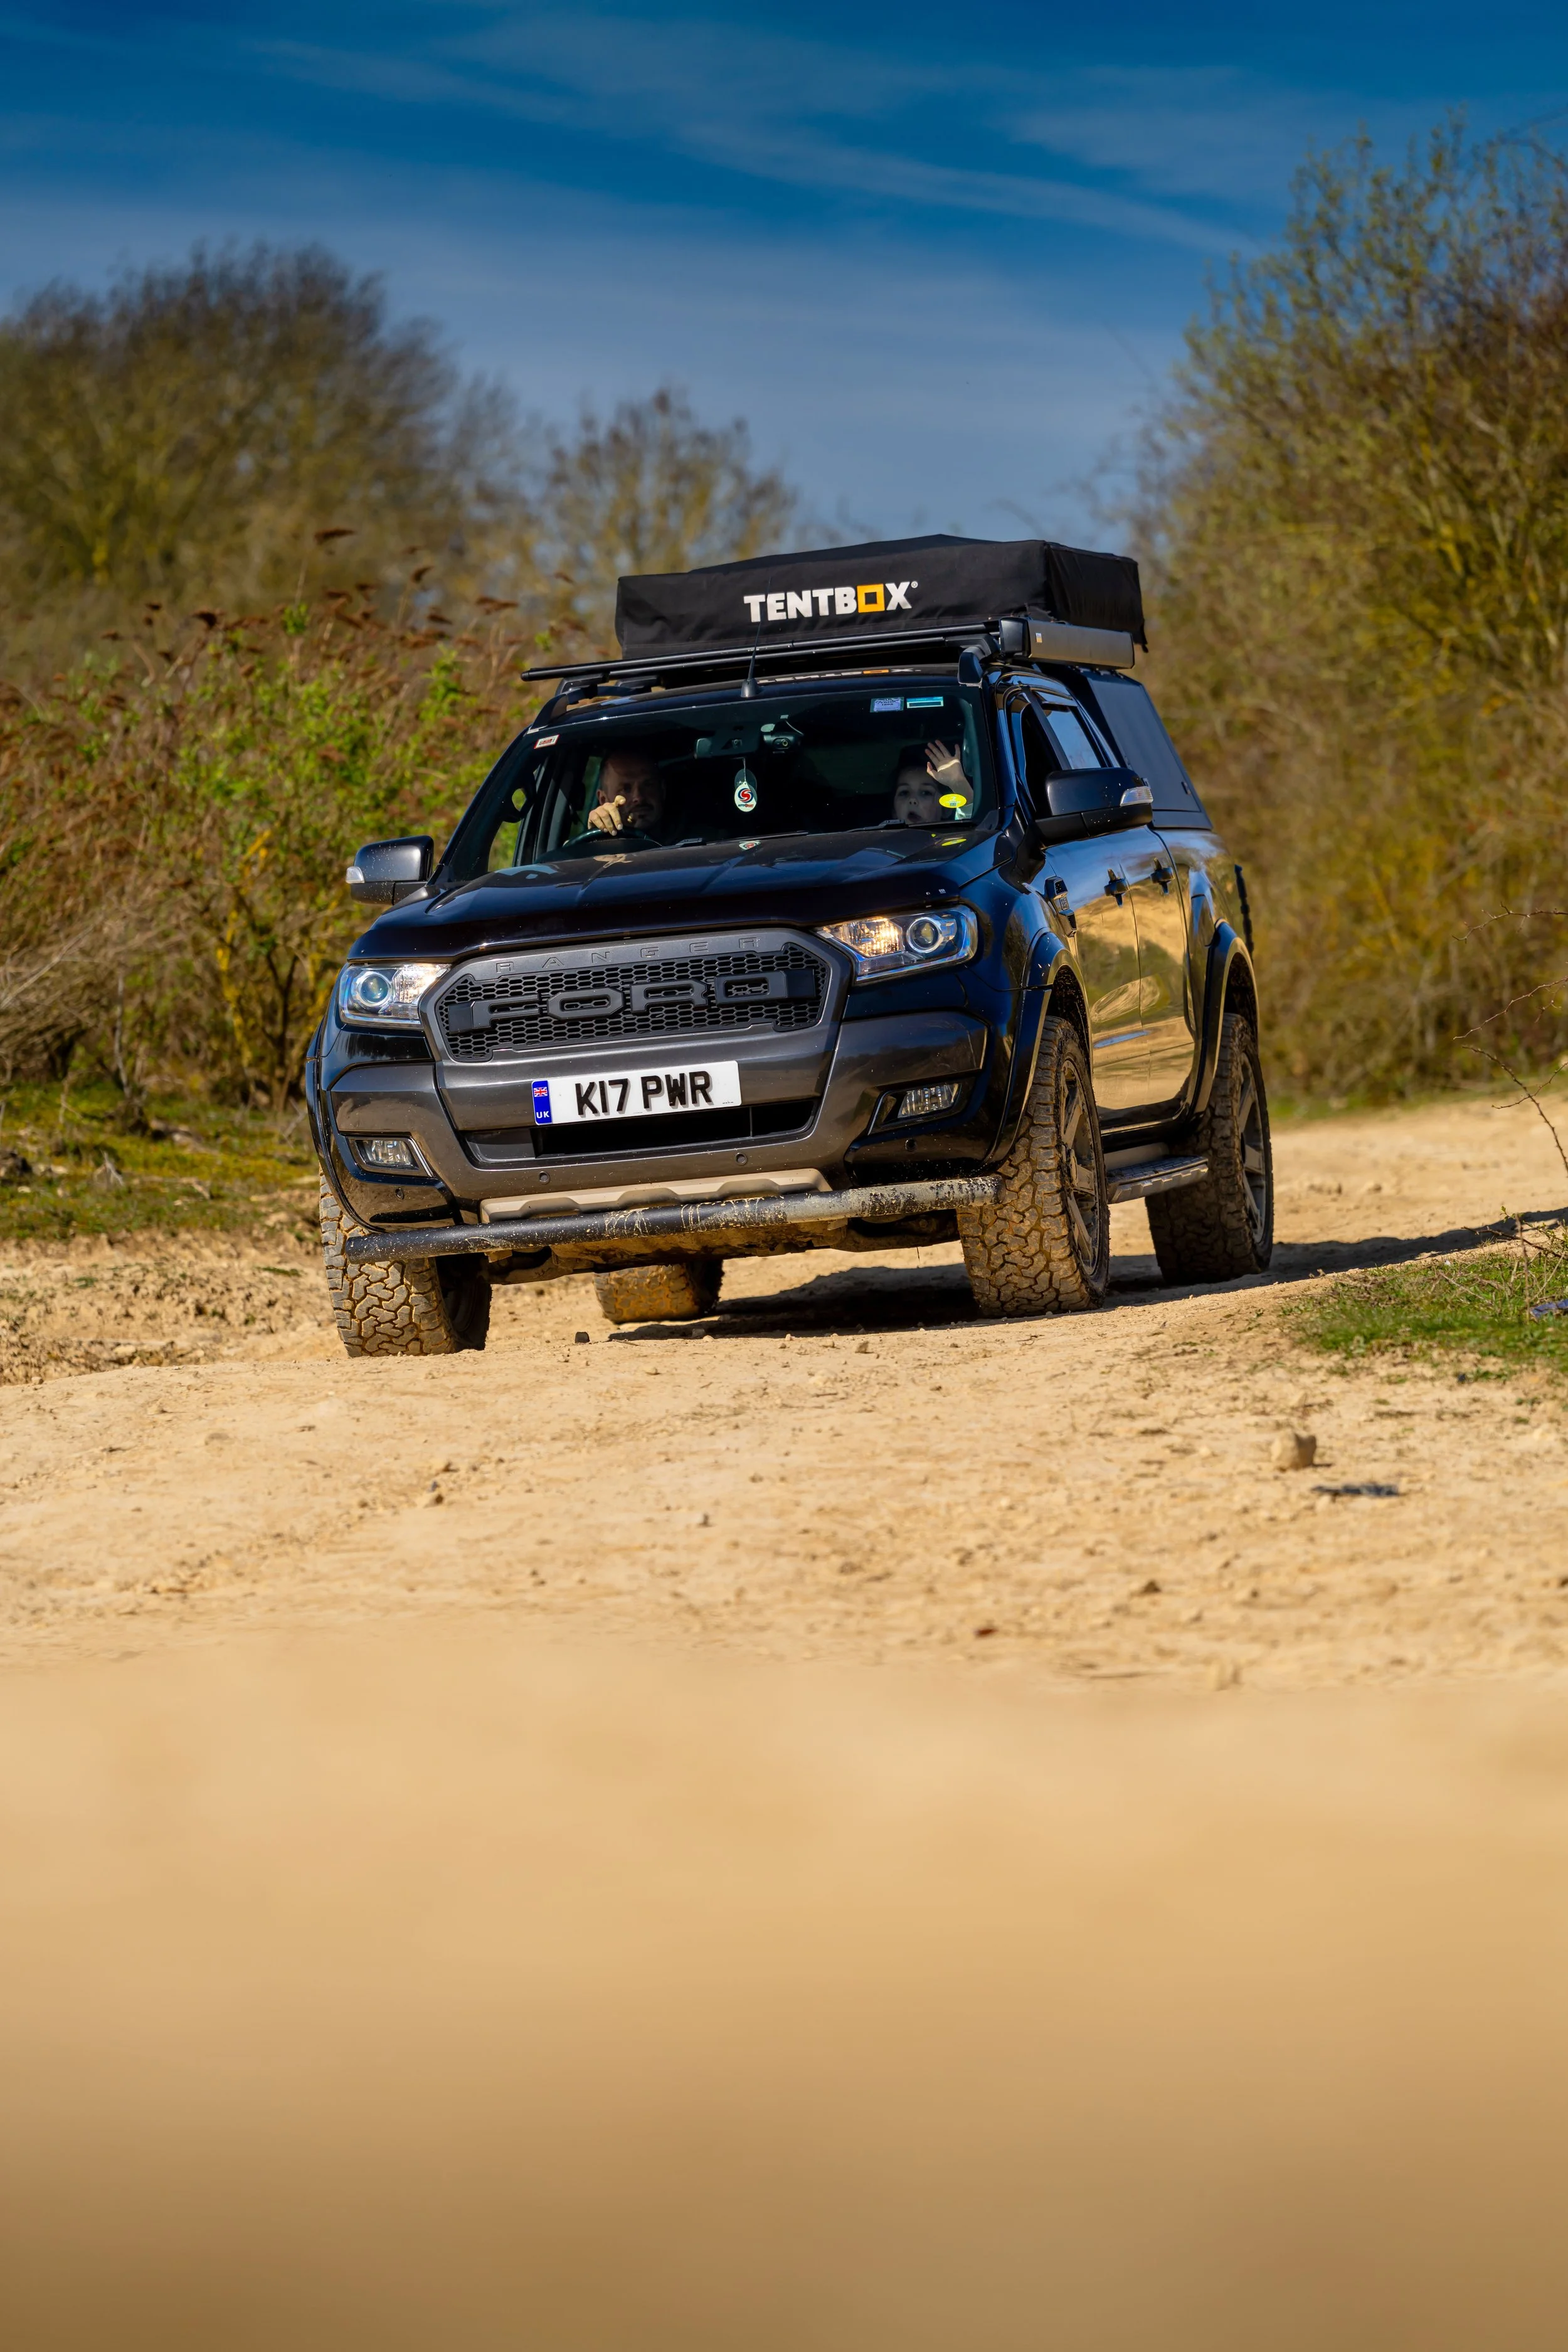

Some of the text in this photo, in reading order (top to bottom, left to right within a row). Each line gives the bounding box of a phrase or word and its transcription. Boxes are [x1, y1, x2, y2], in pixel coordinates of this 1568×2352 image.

[743, 581, 912, 623] TENTBOX
[495, 936, 760, 973] RANGER
[449, 968, 814, 1034] FORD
[536, 1110, 550, 1119] UK
[575, 1071, 712, 1116] K17 PWR
